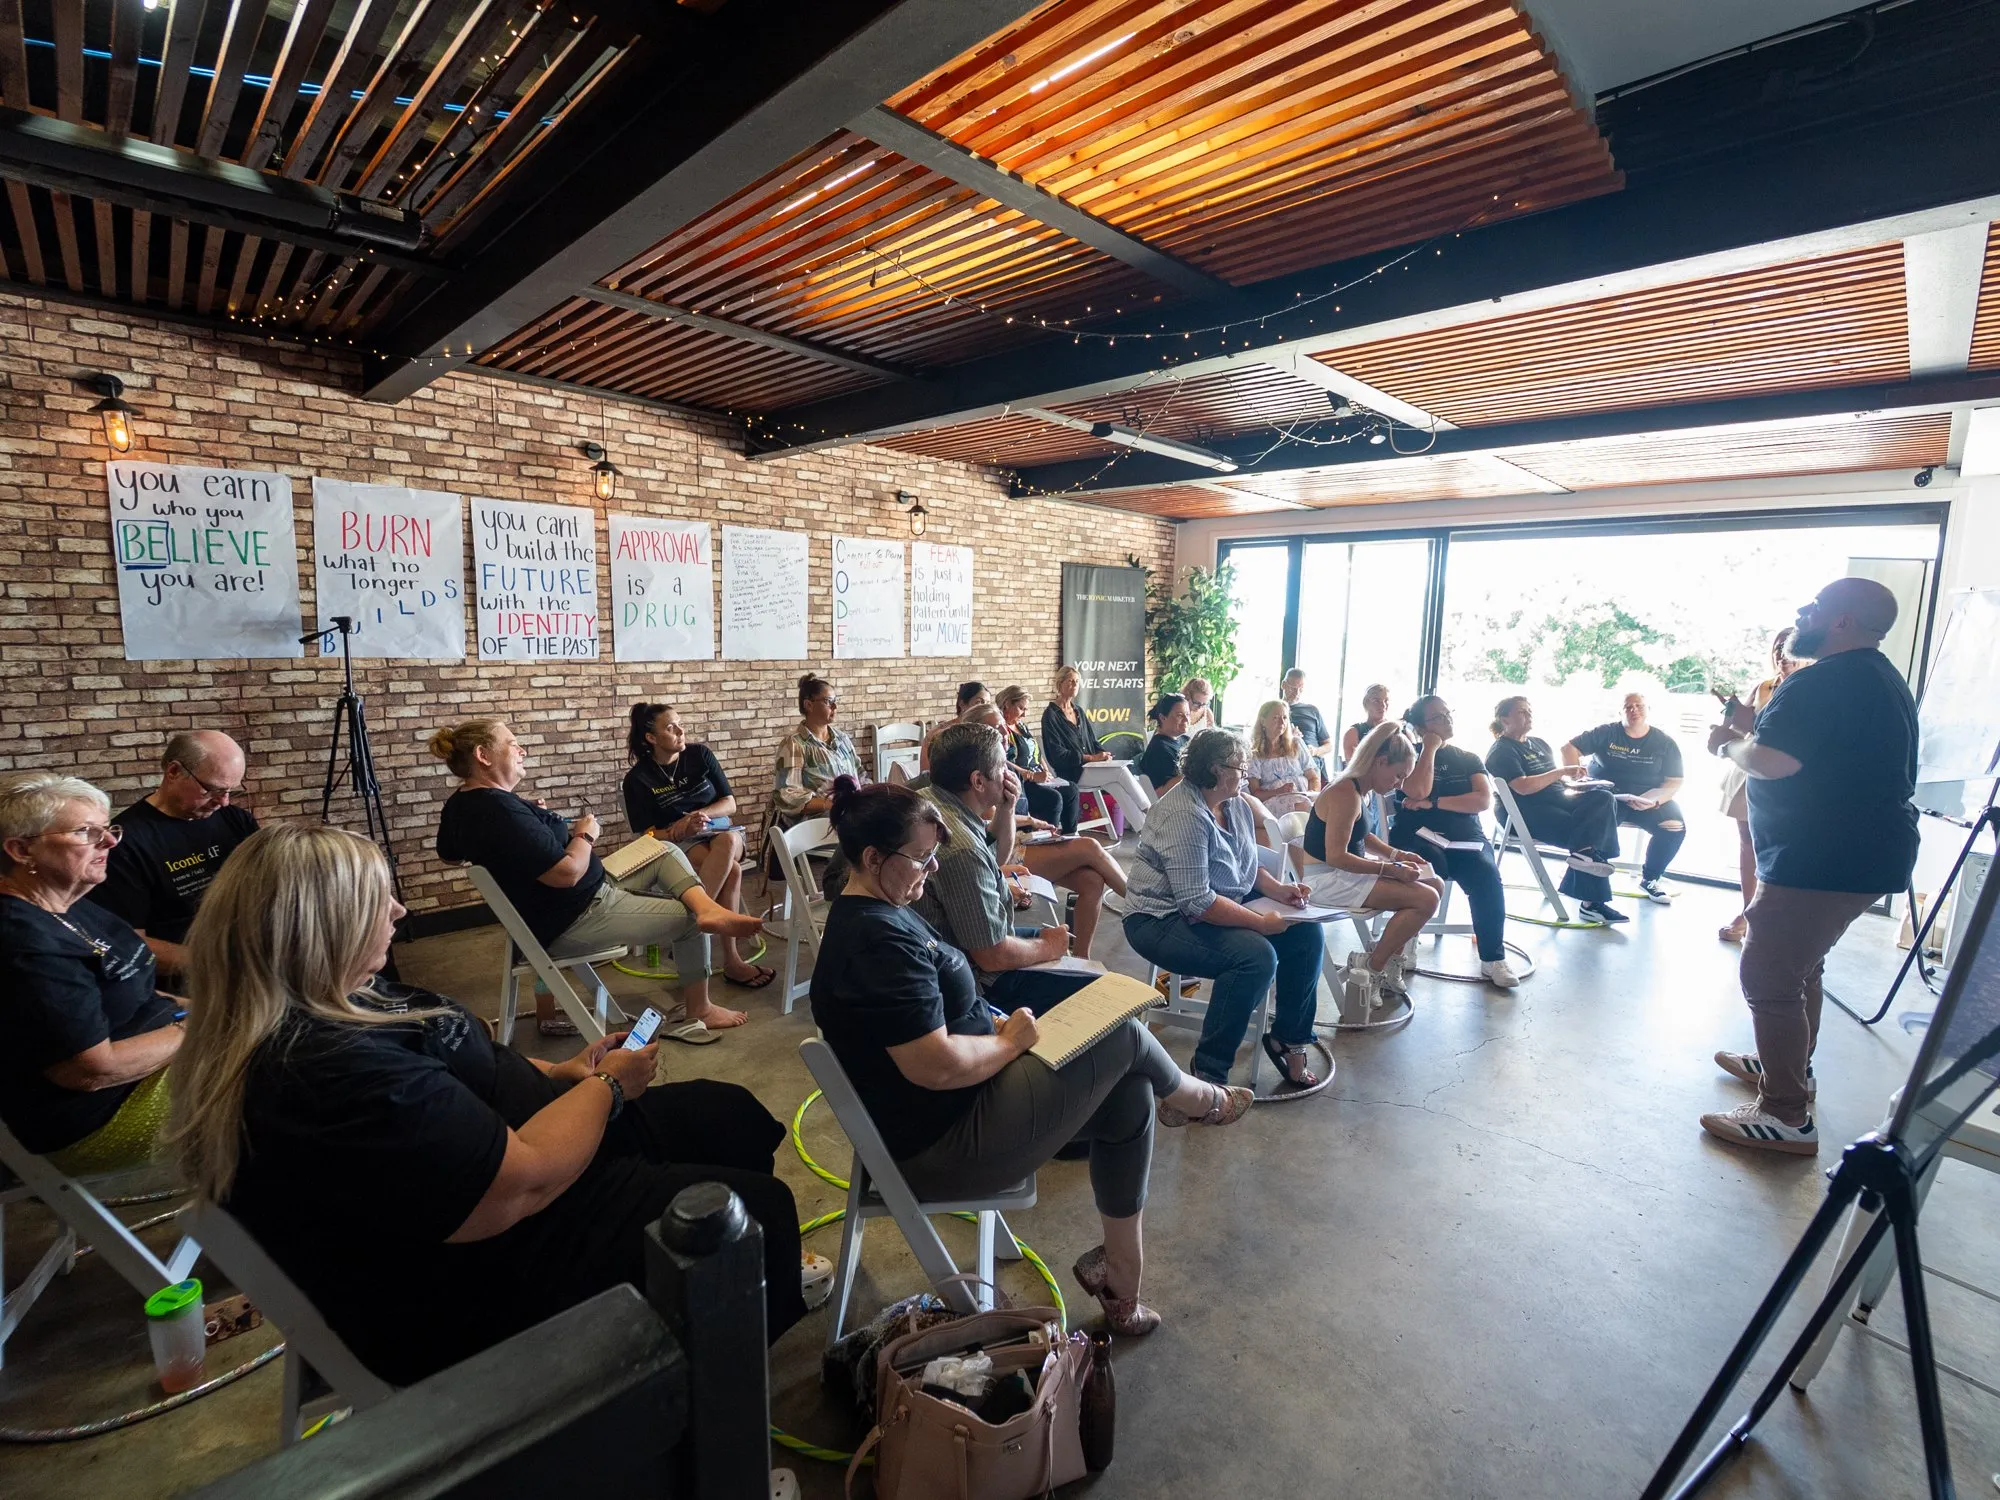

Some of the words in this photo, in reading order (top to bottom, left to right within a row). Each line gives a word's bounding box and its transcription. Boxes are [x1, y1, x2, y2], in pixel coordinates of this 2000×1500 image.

[115, 468, 180, 510] you
[203, 475, 271, 502] earn
[152, 501, 197, 517] who
[206, 507, 243, 528] you
[341, 511, 431, 558] BURN
[481, 510, 527, 550] you
[121, 523, 271, 567] BELIEVE
[506, 534, 557, 561] build
[564, 541, 594, 563] the
[616, 530, 708, 565] APPROVAL
[930, 545, 960, 564] FEAR
[392, 560, 420, 574] no
[914, 563, 925, 580] is
[932, 565, 952, 585] just
[140, 571, 195, 606] you
[215, 571, 265, 593] are!
[351, 573, 420, 597] longer
[482, 563, 592, 595] FUTURE
[627, 573, 645, 596] is
[673, 576, 682, 596] a
[480, 593, 525, 611] with
[537, 595, 570, 611] the
[913, 585, 951, 608] holding
[624, 601, 696, 628] DRUG
[948, 603, 970, 619] until
[497, 613, 596, 638] IDENTITY
[913, 622, 932, 642] you
[937, 622, 969, 645] MOVE
[482, 636, 508, 655] OF
[522, 636, 557, 656] THE
[562, 637, 597, 657] PAST
[1074, 660, 1106, 671] YOUR
[1107, 661, 1138, 672] NEXT
[1080, 678, 1100, 689] VEL
[1102, 678, 1144, 689] STARTS
[1086, 707, 1131, 723] NOW!
[651, 784, 677, 795] Iconic
[165, 853, 206, 872] Iconic
